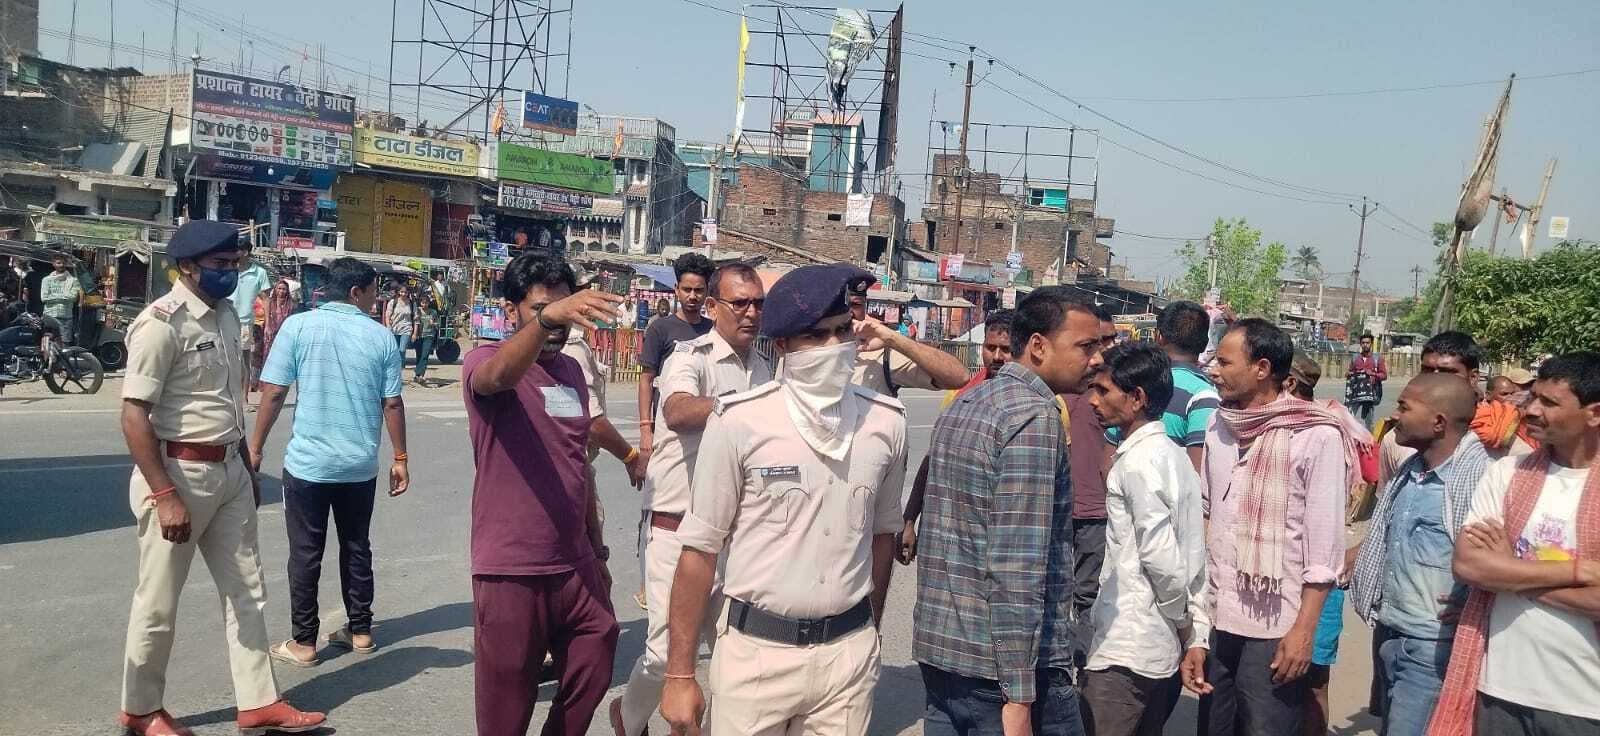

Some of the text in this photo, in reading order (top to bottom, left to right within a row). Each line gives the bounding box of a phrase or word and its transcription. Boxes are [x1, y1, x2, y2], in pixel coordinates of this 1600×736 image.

[249, 82, 283, 100] टायर
[324, 91, 352, 113] शॉप
[526, 102, 549, 115] CEAT
[374, 135, 410, 155] टाटा
[414, 140, 464, 162] डीजल
